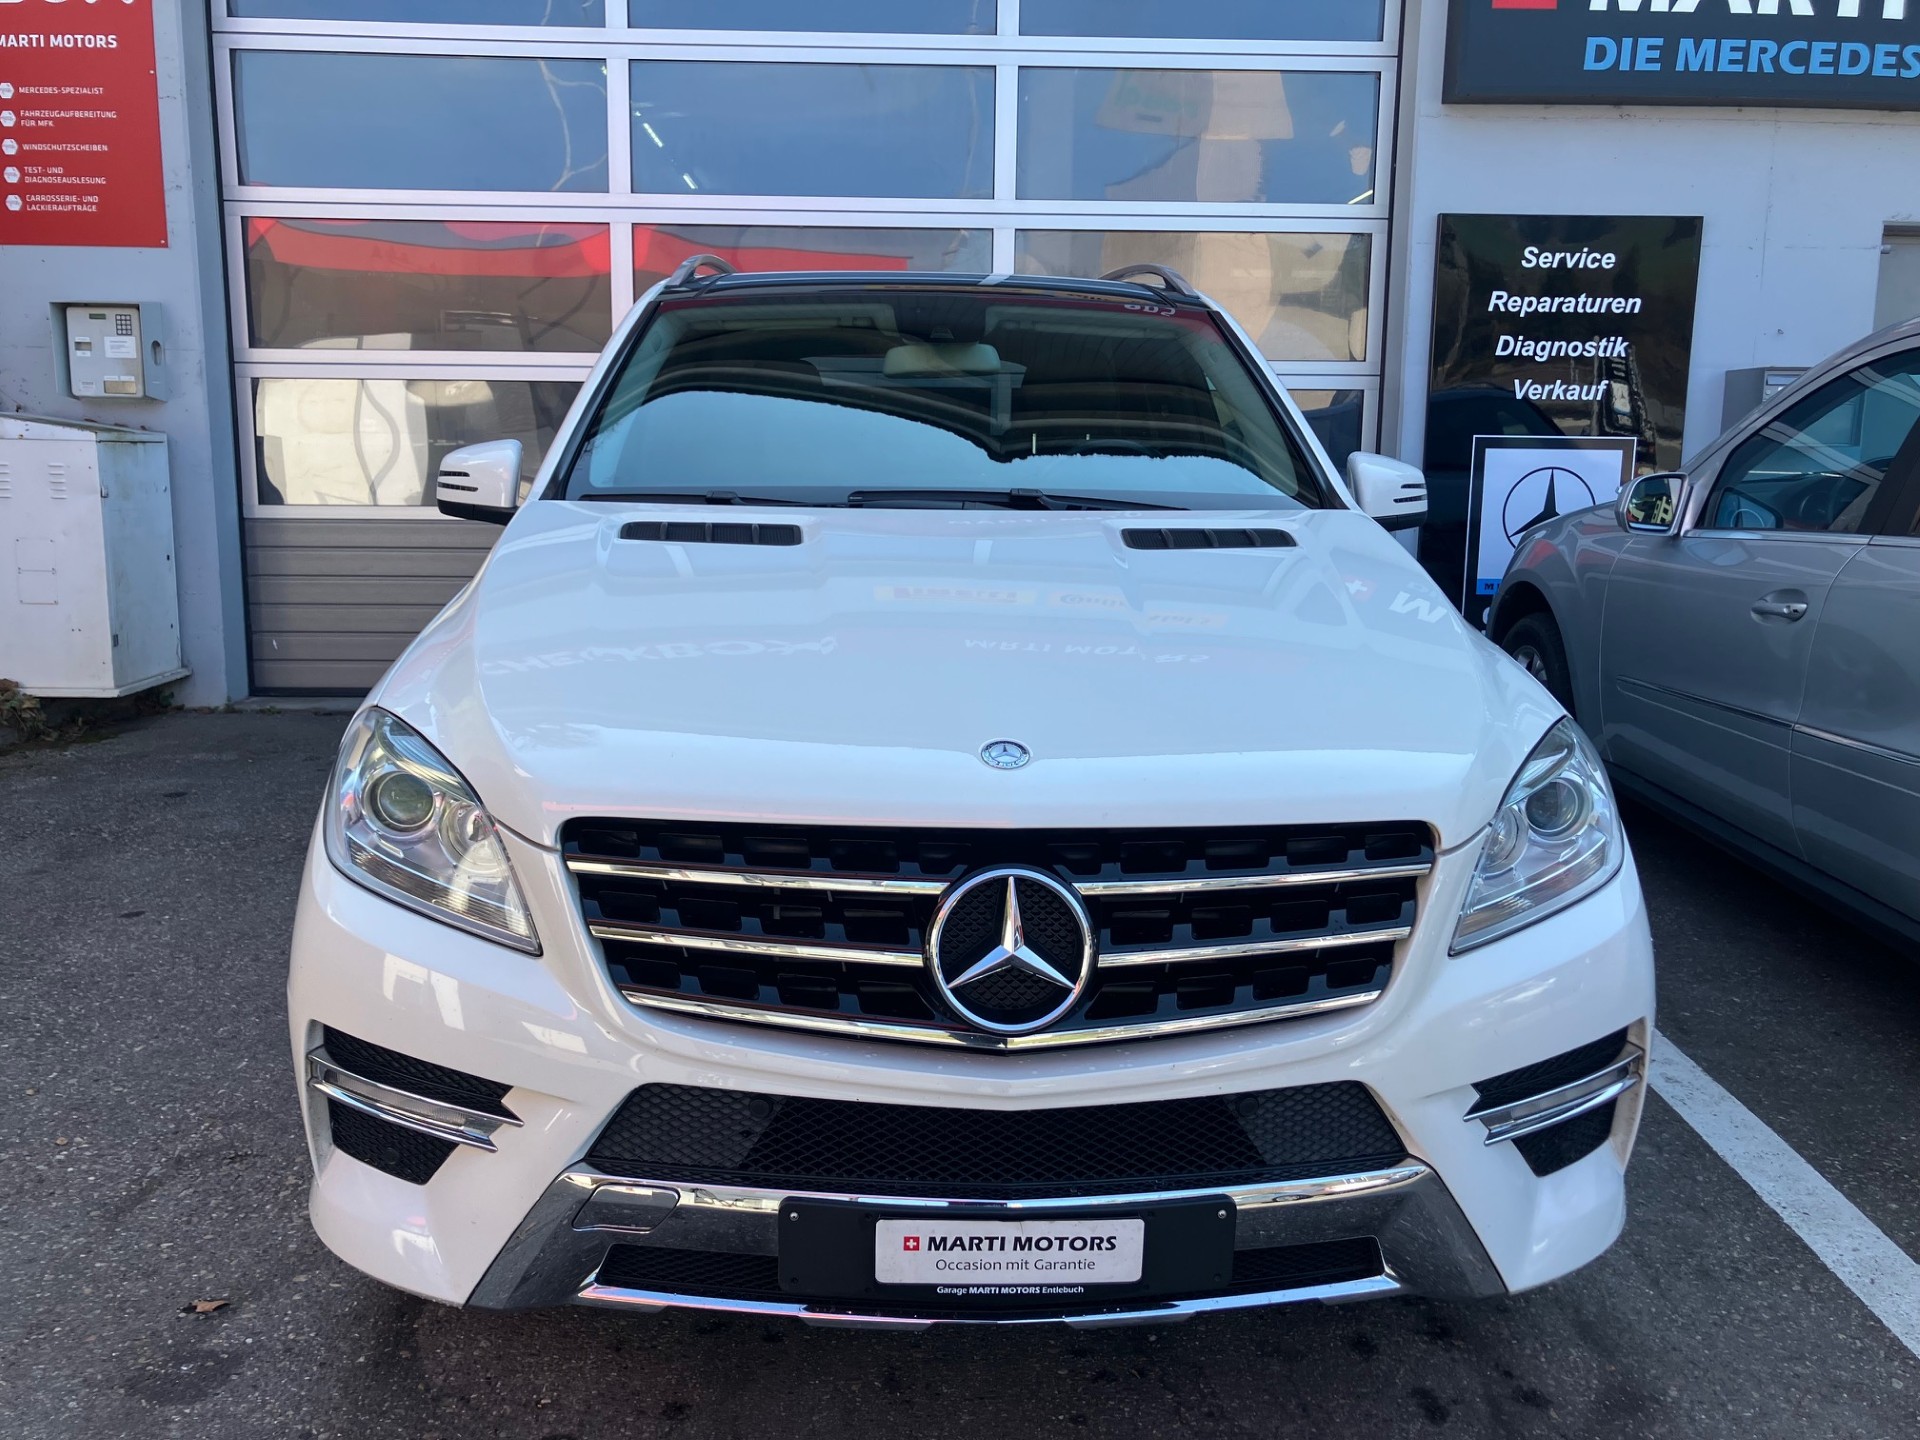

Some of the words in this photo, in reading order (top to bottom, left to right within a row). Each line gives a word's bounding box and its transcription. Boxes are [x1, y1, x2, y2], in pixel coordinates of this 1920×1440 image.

[50, 34, 117, 48] MOTORS
[1583, 36, 1664, 71] DIE
[1675, 37, 1920, 78] MERCEDES
[18, 86, 103, 95] MERCEDES-SPEZIALIST
[20, 110, 117, 118] FAHRZEUGAUFBEREITUNG
[20, 119, 36, 127] FÜR
[22, 143, 108, 151] WINDSCHUTZSCHEIBEN
[24, 166, 46, 174] TEST-
[24, 176, 106, 184] DIAGNOSEAUSLESUNG
[26, 194, 81, 203] CARROSSERIE-
[82, 195, 99, 203] UND
[26, 203, 97, 212] LACKIERAUFTRÄGE
[1521, 246, 1616, 270] Service
[1488, 291, 1642, 318] Reparaturen
[1495, 335, 1630, 362] Diagnostik
[1513, 378, 1609, 401] Verkauf
[927, 1235, 1006, 1252] MARTI
[1012, 1235, 1117, 1252] MOTORS
[935, 1258, 1002, 1272] Occasion
[1006, 1258, 1030, 1271] mit
[1034, 1257, 1096, 1272] Garantie
[936, 1285, 968, 1296] Garage
[969, 1285, 999, 1295] MARTI
[1001, 1285, 1040, 1295] MOTORS
[1042, 1284, 1084, 1294] Entlebuch
